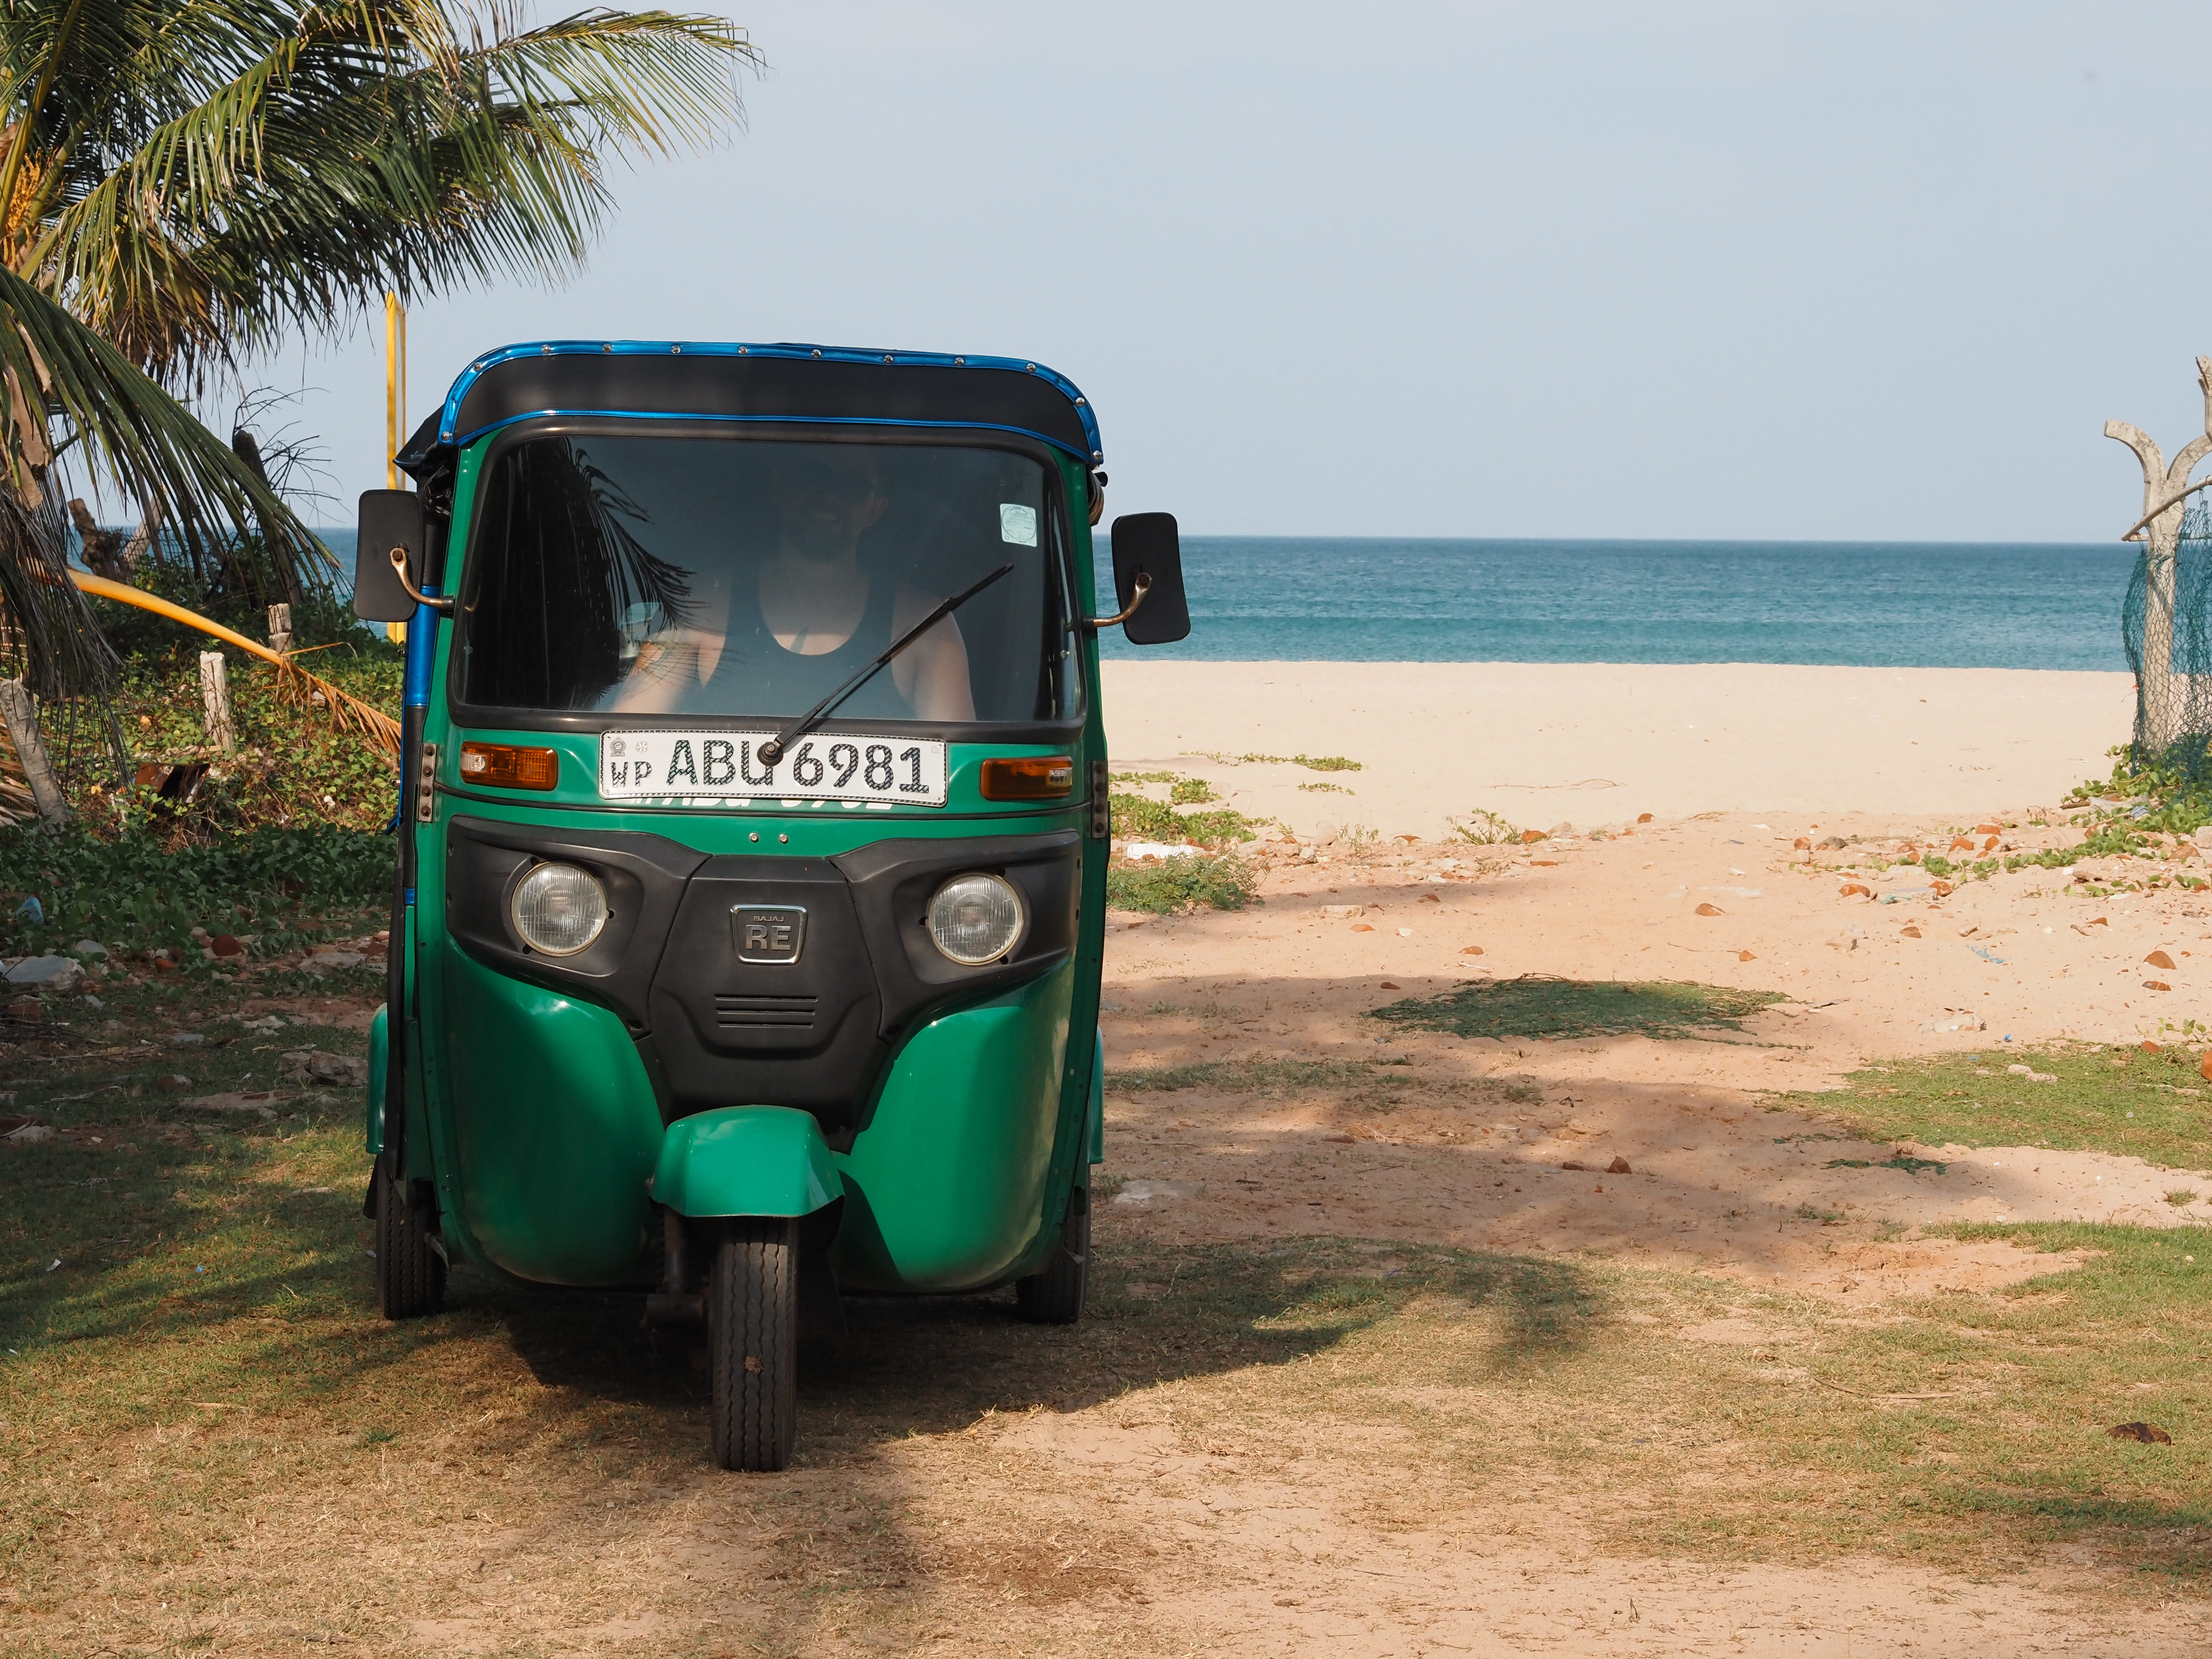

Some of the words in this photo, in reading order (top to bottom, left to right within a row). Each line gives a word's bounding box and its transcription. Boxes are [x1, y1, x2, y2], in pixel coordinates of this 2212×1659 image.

[611, 761, 652, 787] WP
[666, 739, 774, 786] ABU
[793, 742, 929, 793] 6981
[746, 924, 791, 951] RE
